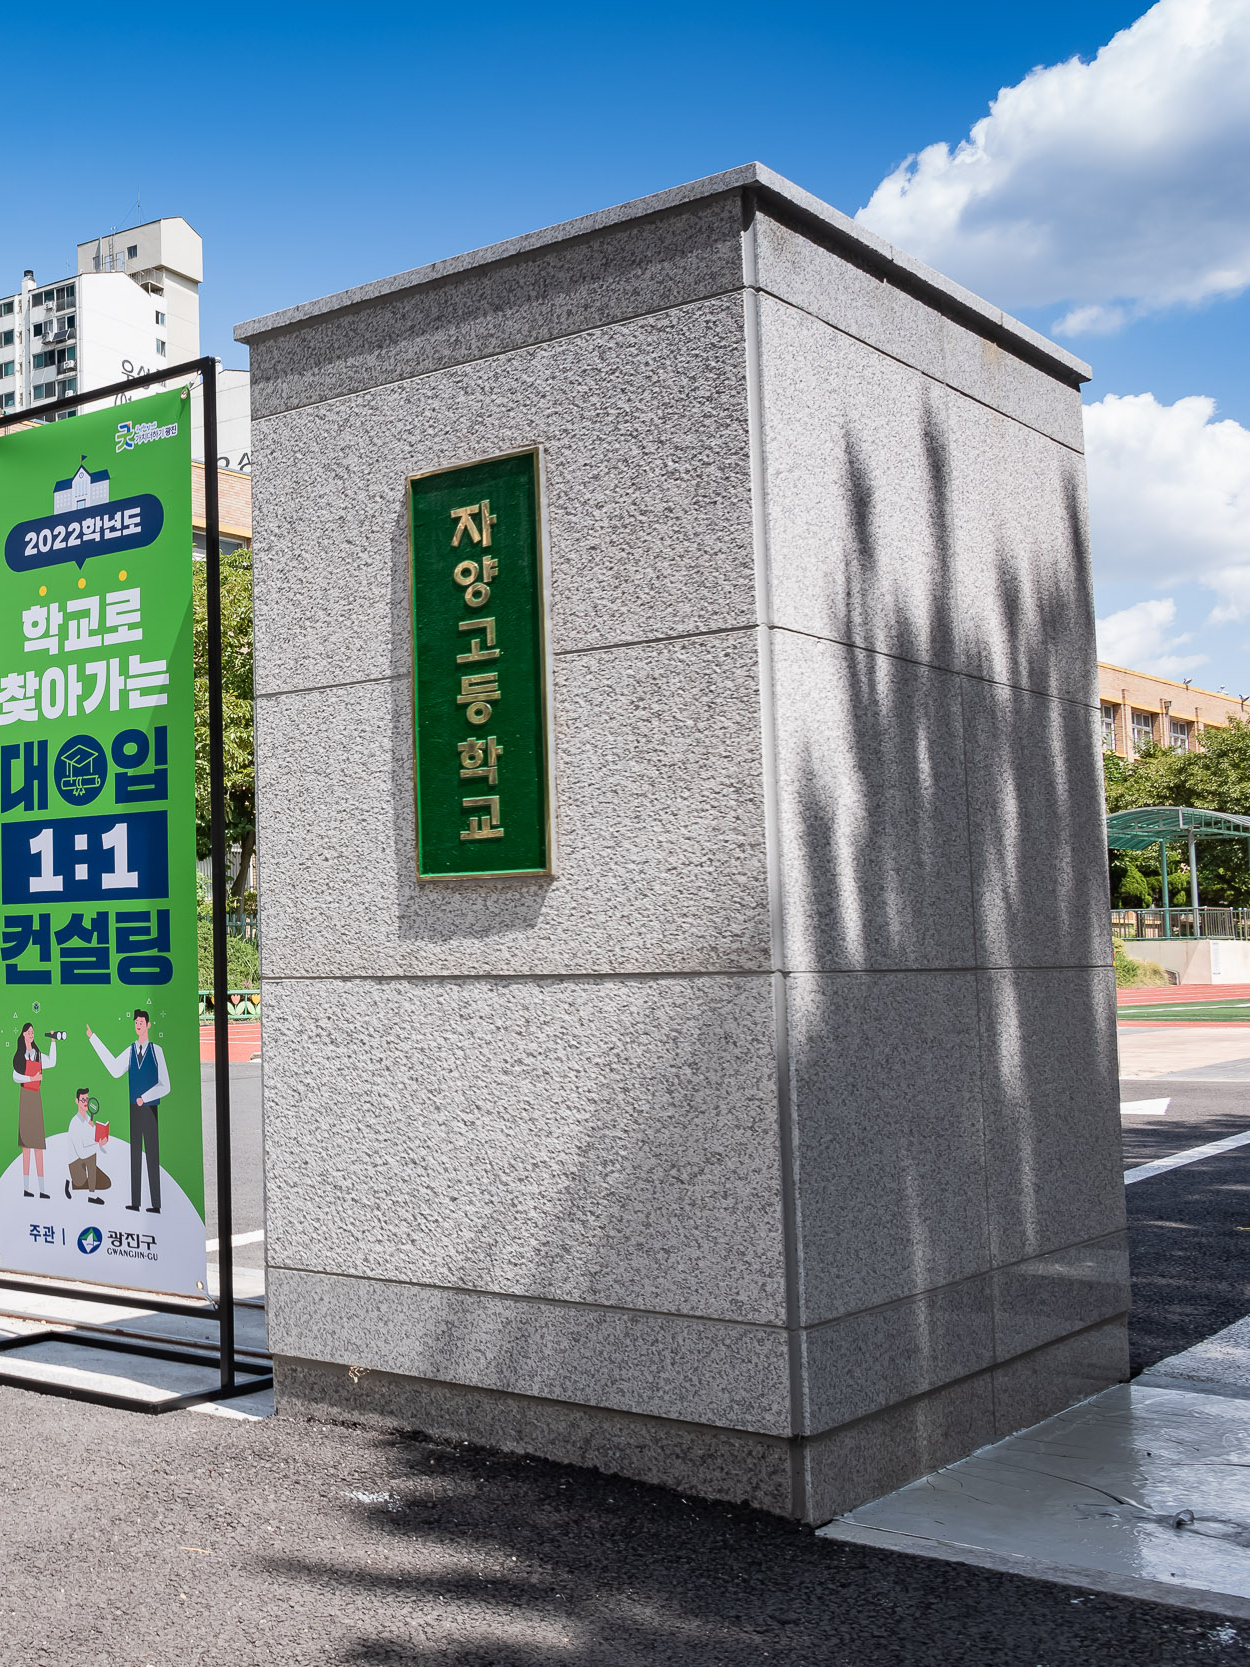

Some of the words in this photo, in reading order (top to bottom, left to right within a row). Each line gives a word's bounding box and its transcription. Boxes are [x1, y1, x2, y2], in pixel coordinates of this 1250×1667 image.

[165, 424, 177, 436] 광진
[24, 507, 142, 556] 2022학년도
[22, 587, 143, 655] 학교로
[450, 499, 504, 841] 자양고등학교
[29, 823, 138, 892] 1:1
[0, 909, 173, 985] 컨설팅
[29, 1224, 55, 1244] 주관
[107, 1230, 157, 1251] 광진구
[107, 1247, 158, 1262] GWANGJIN-GU
